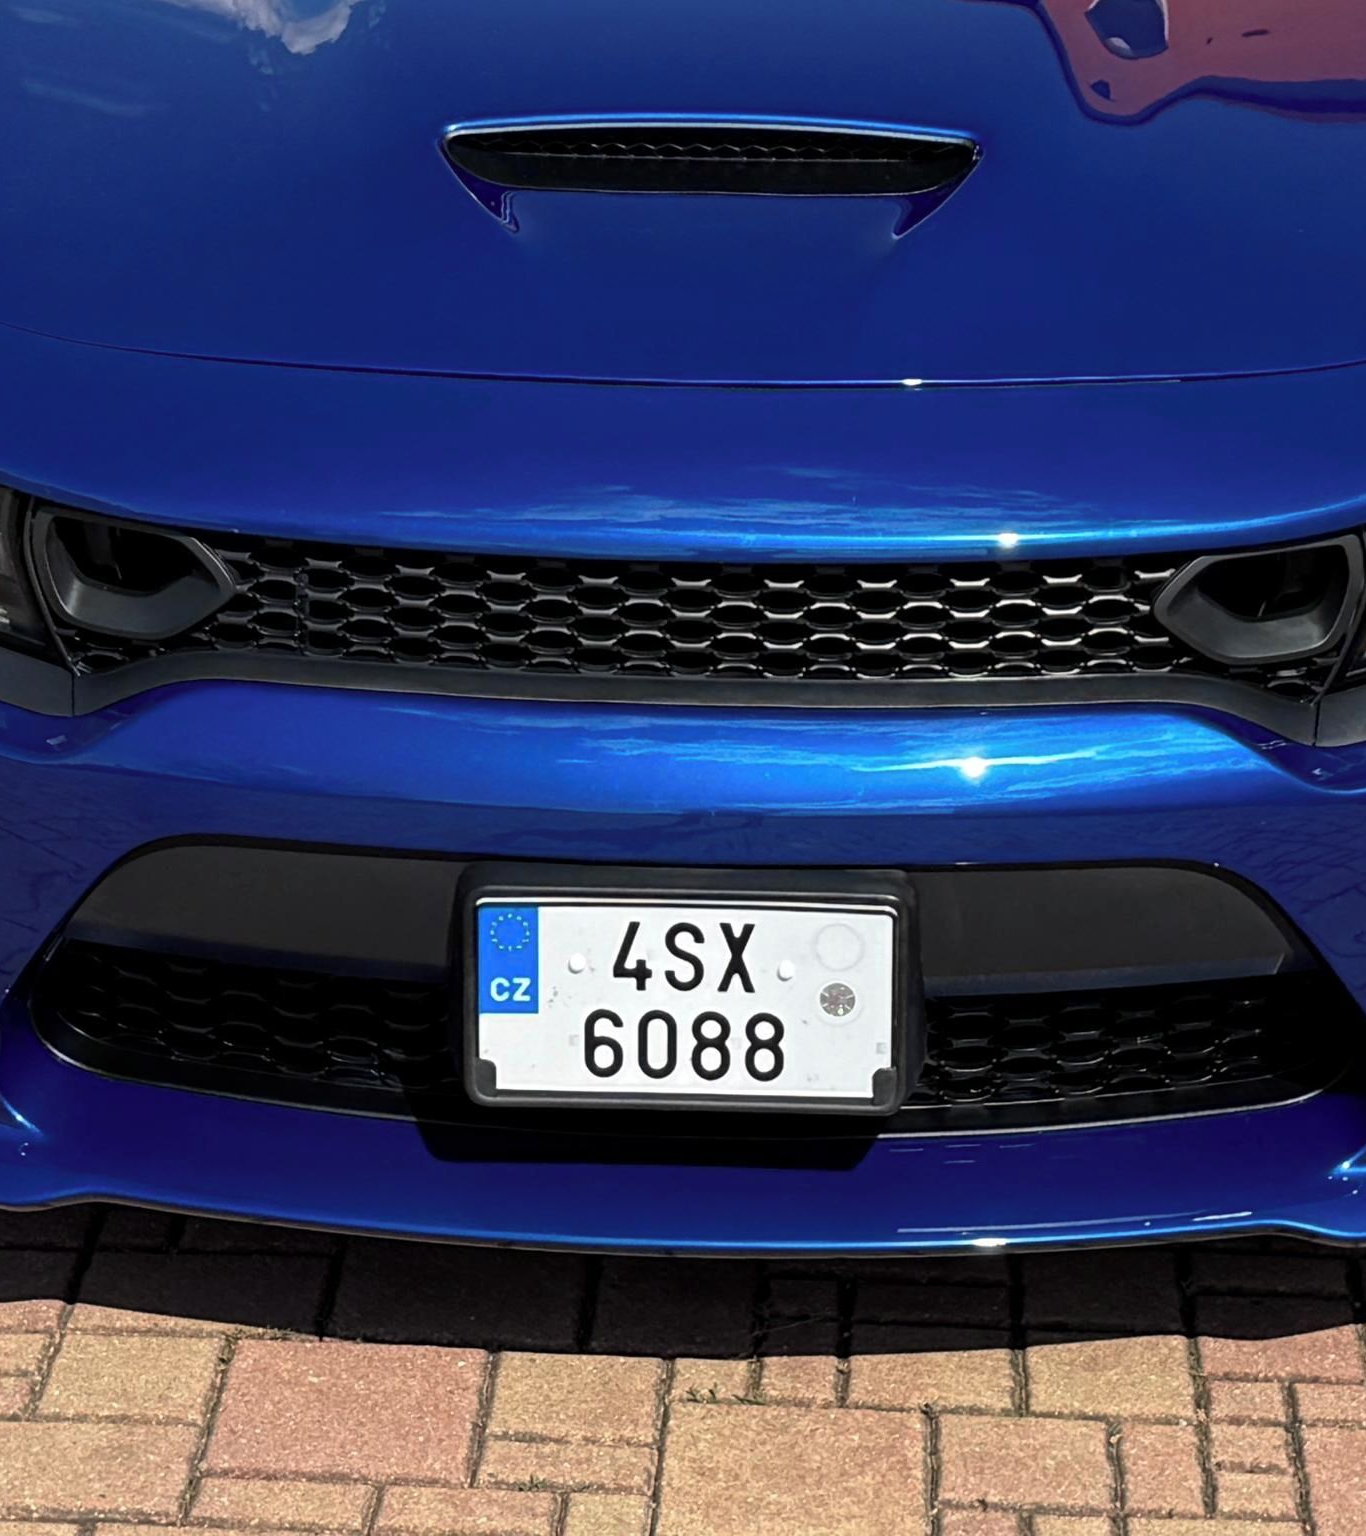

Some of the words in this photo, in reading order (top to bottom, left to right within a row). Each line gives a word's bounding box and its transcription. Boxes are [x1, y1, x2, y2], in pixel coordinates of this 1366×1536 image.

[490, 977, 531, 1002] CZ
[612, 921, 756, 993] 4SX
[584, 1008, 785, 1082] 6088
